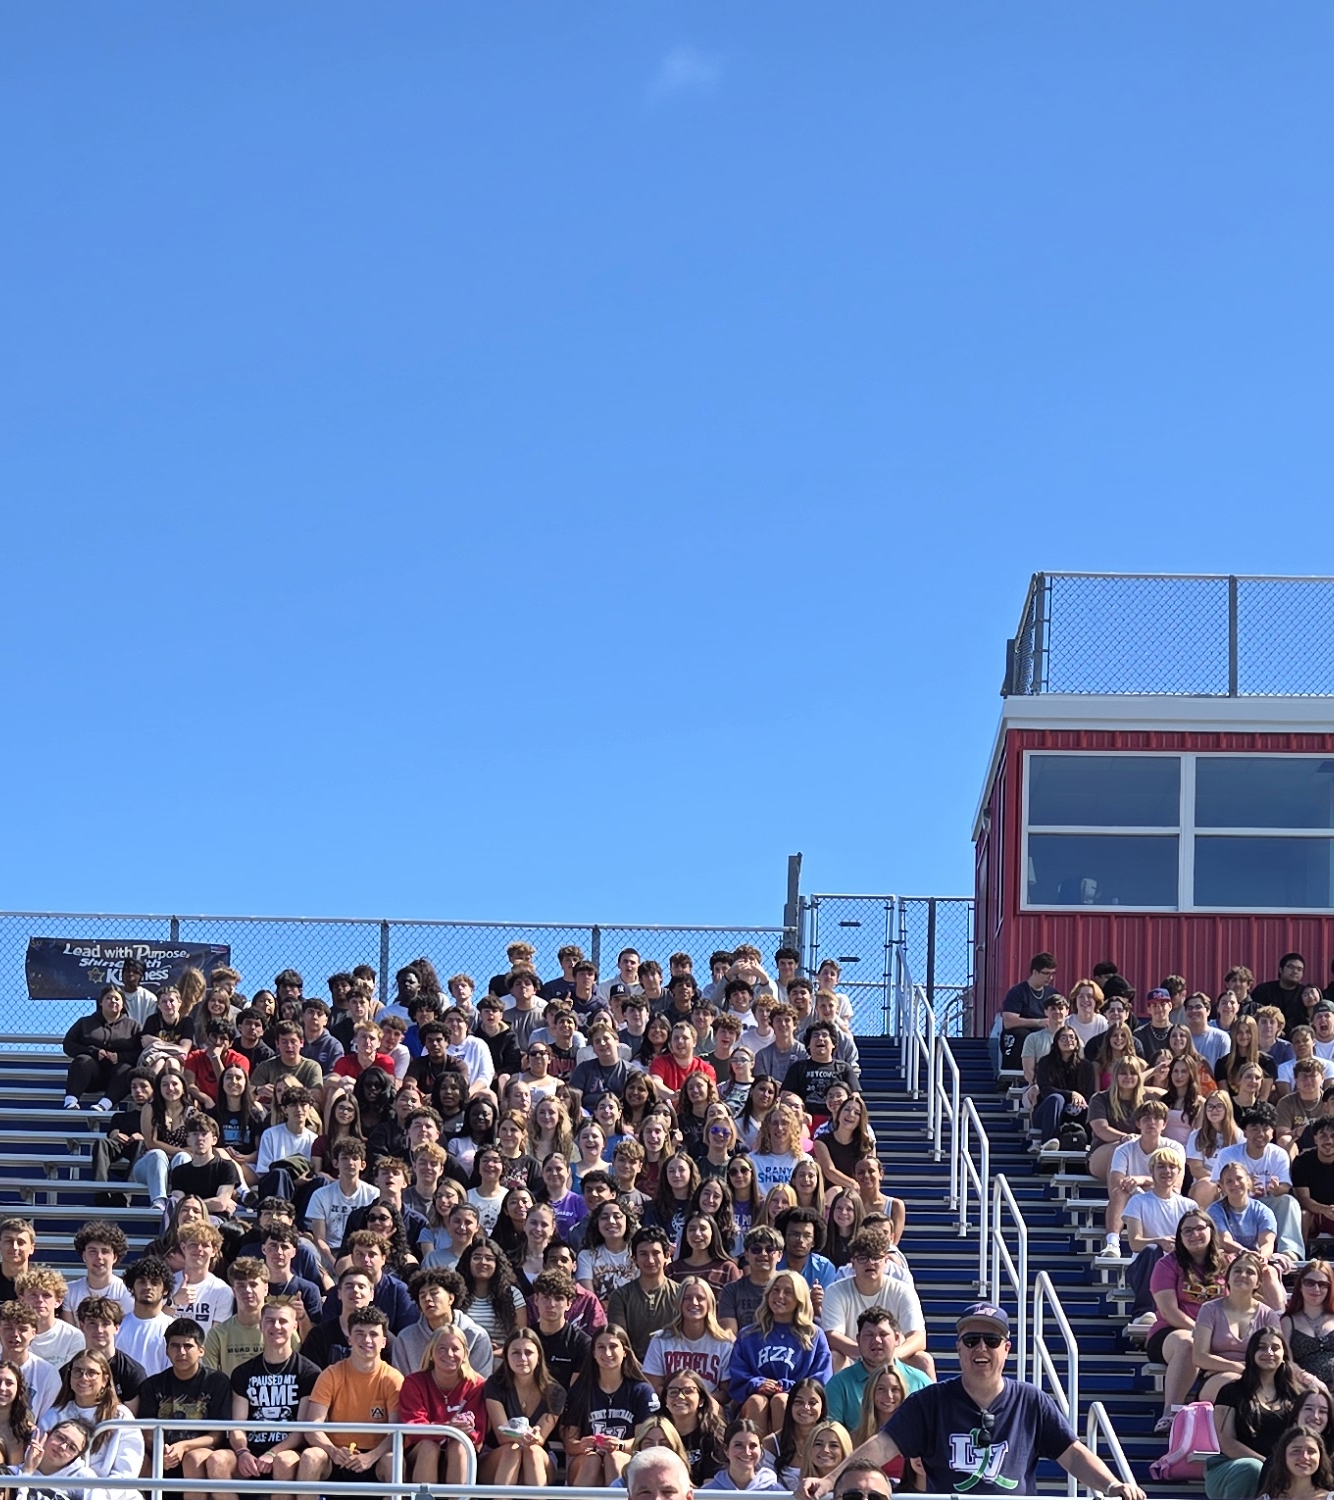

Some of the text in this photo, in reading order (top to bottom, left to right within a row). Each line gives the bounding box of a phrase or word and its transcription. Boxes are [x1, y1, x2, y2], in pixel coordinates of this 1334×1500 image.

[63, 943, 190, 960] Lead with Purpose,
[664, 1350, 720, 1384] REBELS
